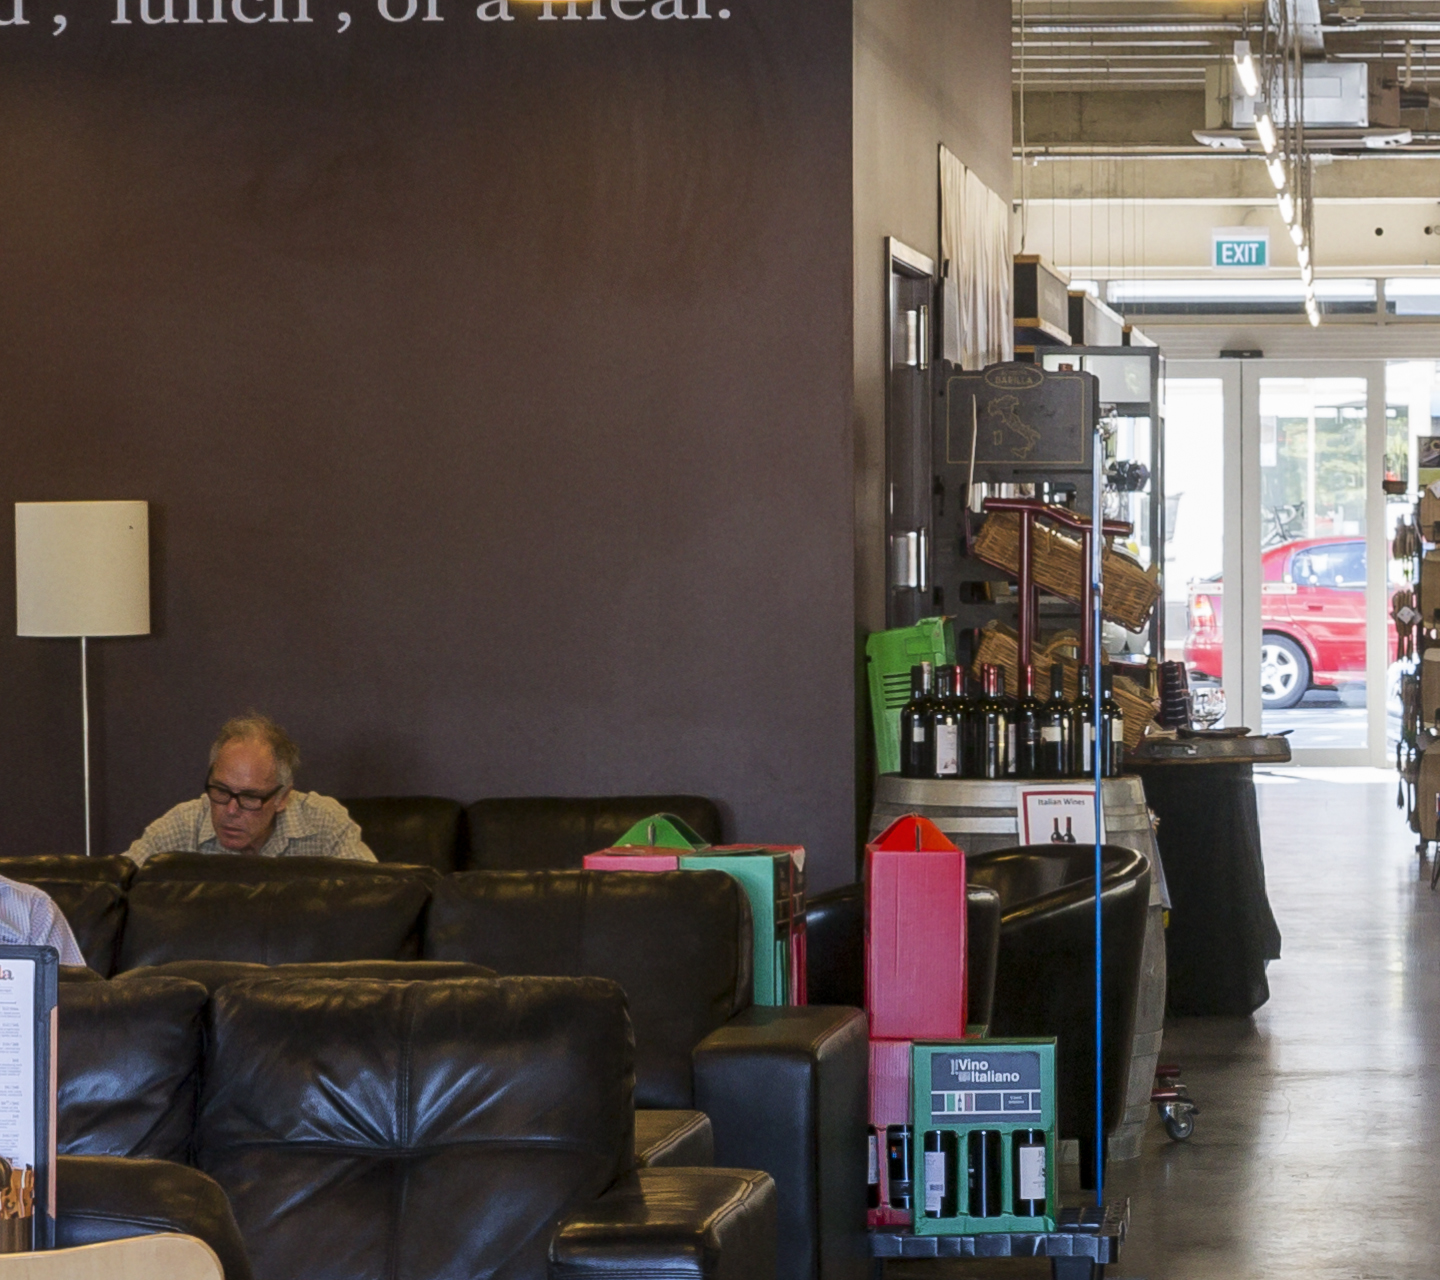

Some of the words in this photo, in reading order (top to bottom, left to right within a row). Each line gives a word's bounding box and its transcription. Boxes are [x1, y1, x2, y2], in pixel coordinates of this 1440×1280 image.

[1221, 242, 1260, 264] EXIT
[1037, 797, 1061, 806] Italian
[1063, 797, 1086, 807] Wines
[958, 1057, 989, 1071] Vino
[970, 1070, 1020, 1083] Italiano
